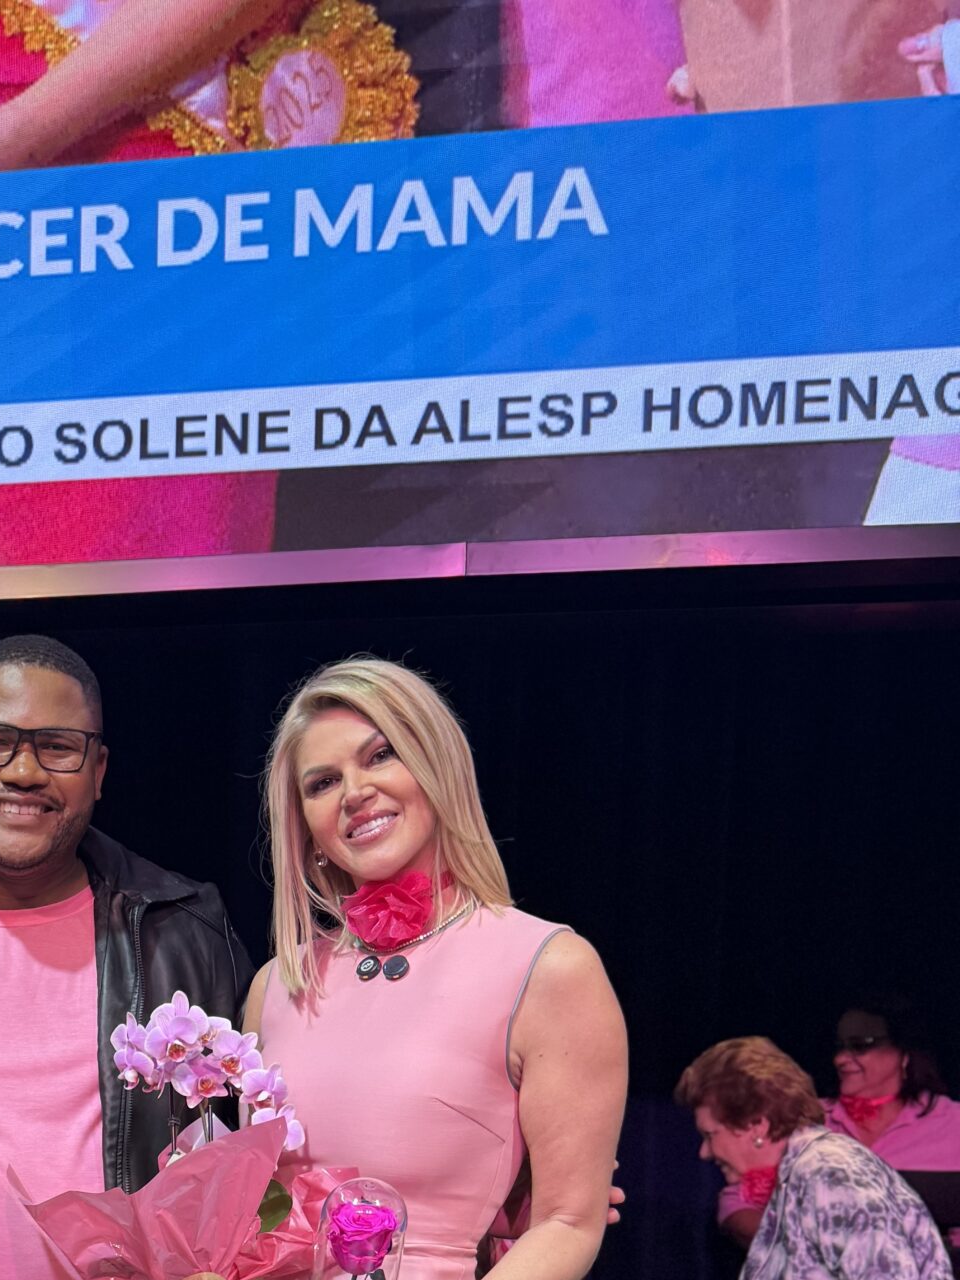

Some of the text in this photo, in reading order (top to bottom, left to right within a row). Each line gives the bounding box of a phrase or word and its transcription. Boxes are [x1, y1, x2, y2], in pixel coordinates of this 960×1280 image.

[157, 192, 270, 267] DE
[294, 167, 608, 257] MAMA
[53, 409, 291, 465] SOLENE
[313, 404, 398, 451] DA
[410, 390, 618, 446] ALESP
